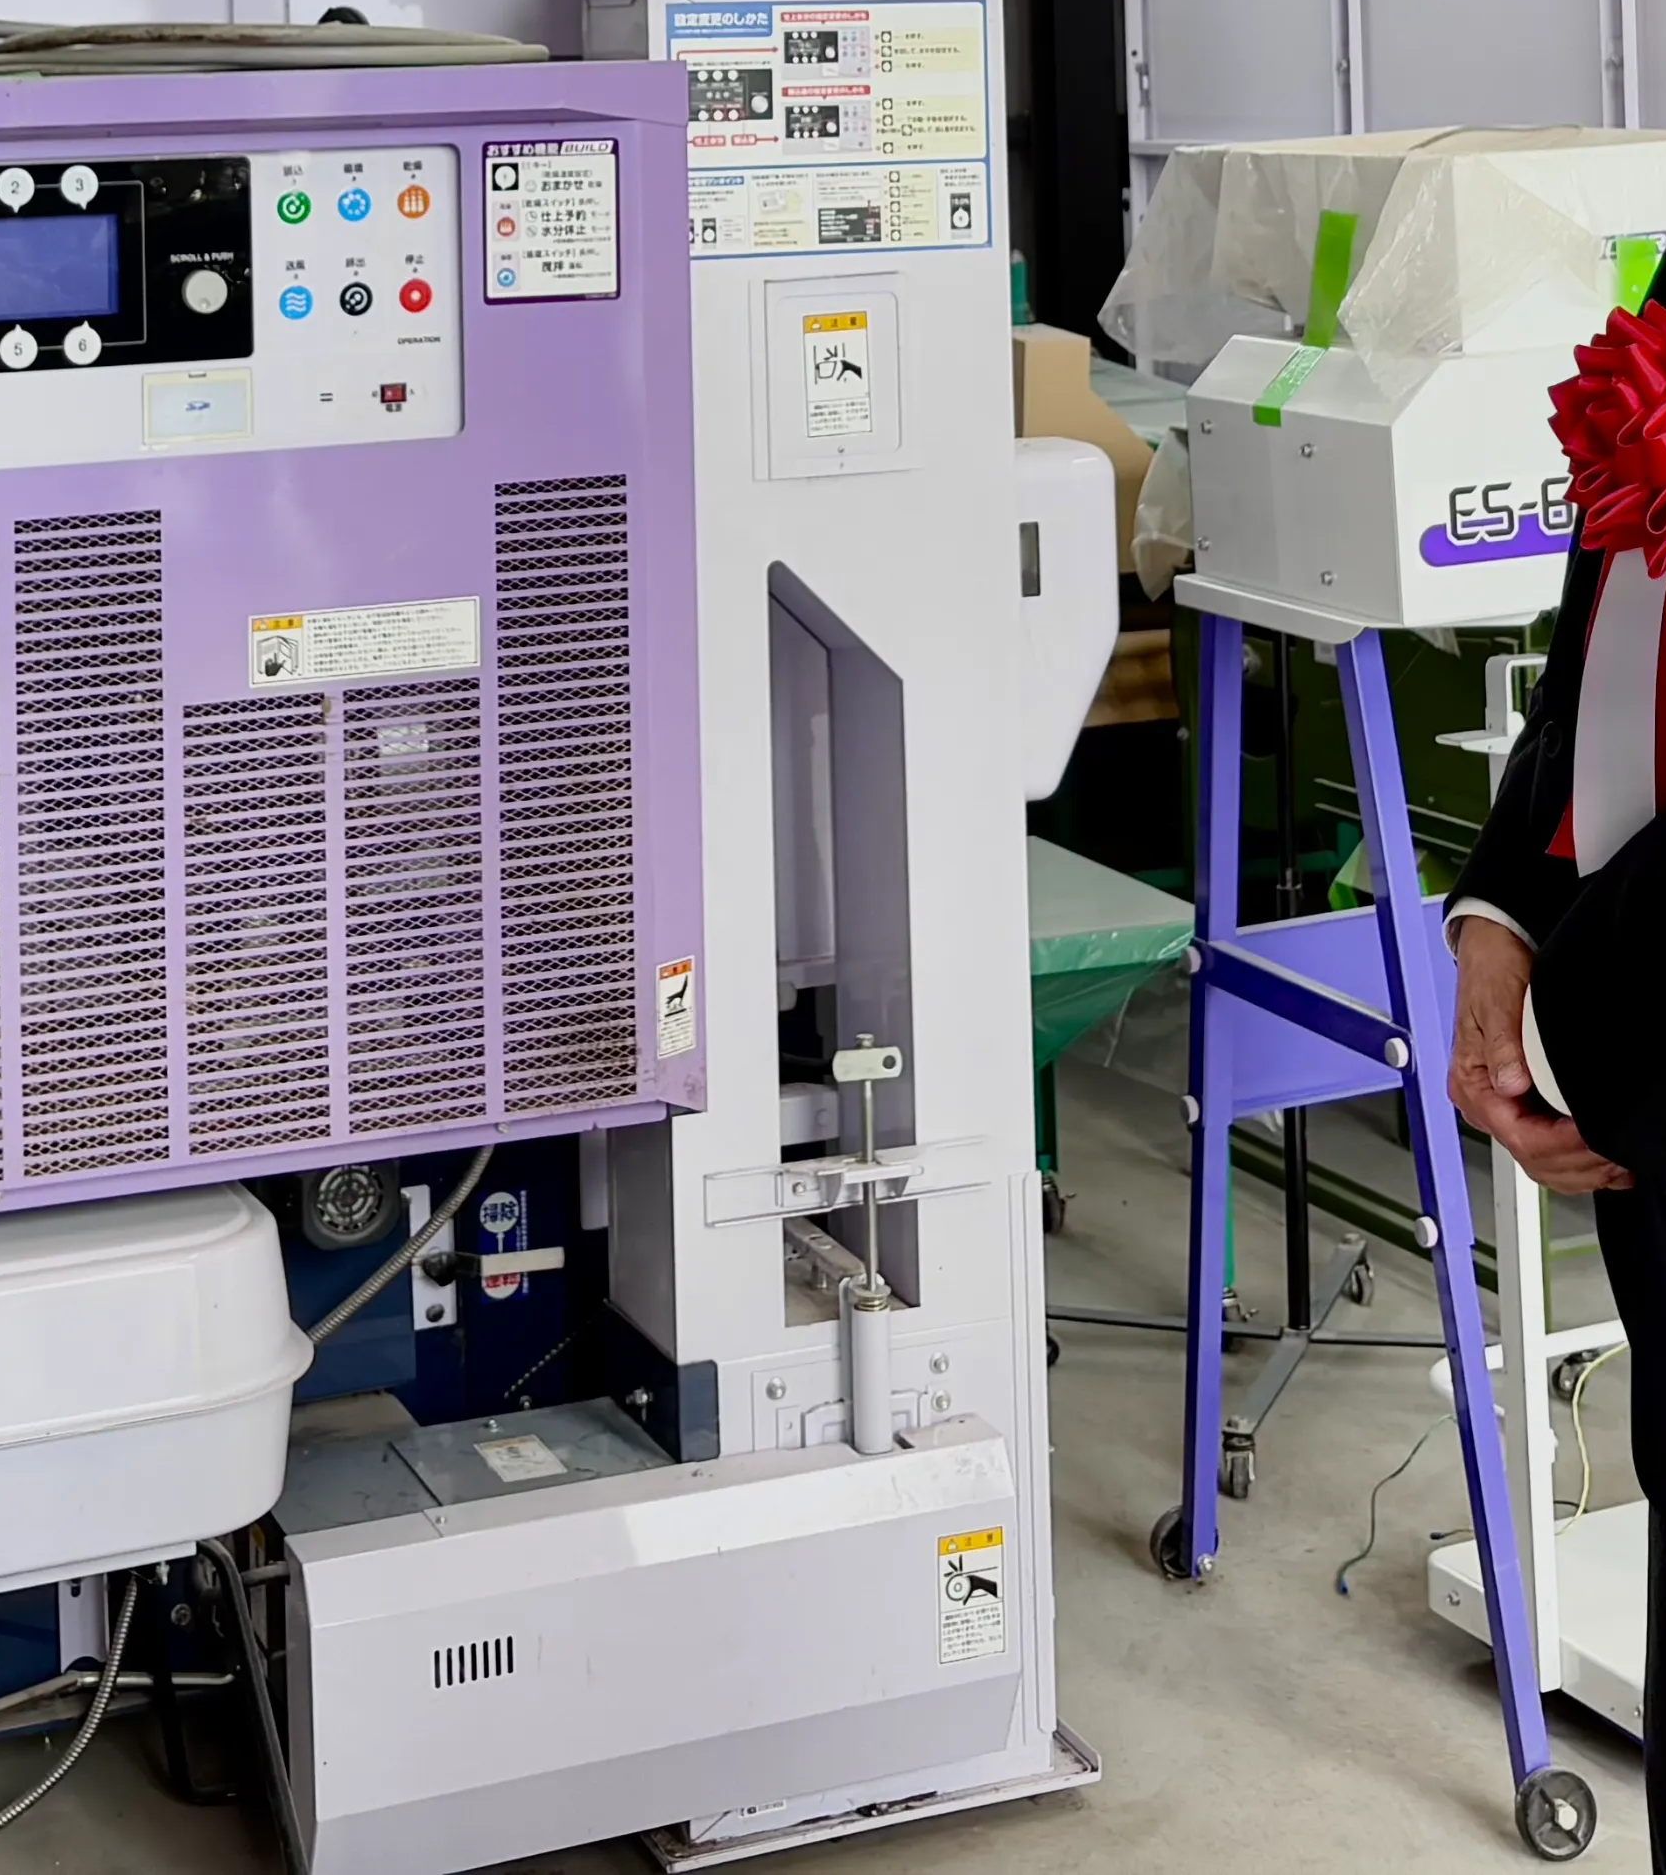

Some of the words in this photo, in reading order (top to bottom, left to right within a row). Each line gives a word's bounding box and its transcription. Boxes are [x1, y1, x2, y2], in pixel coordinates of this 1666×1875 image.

[564, 142, 610, 154] BUILD
[10, 181, 20, 194] 2
[75, 178, 85, 191] 3
[14, 343, 23, 356] 5
[78, 339, 87, 353] 6
